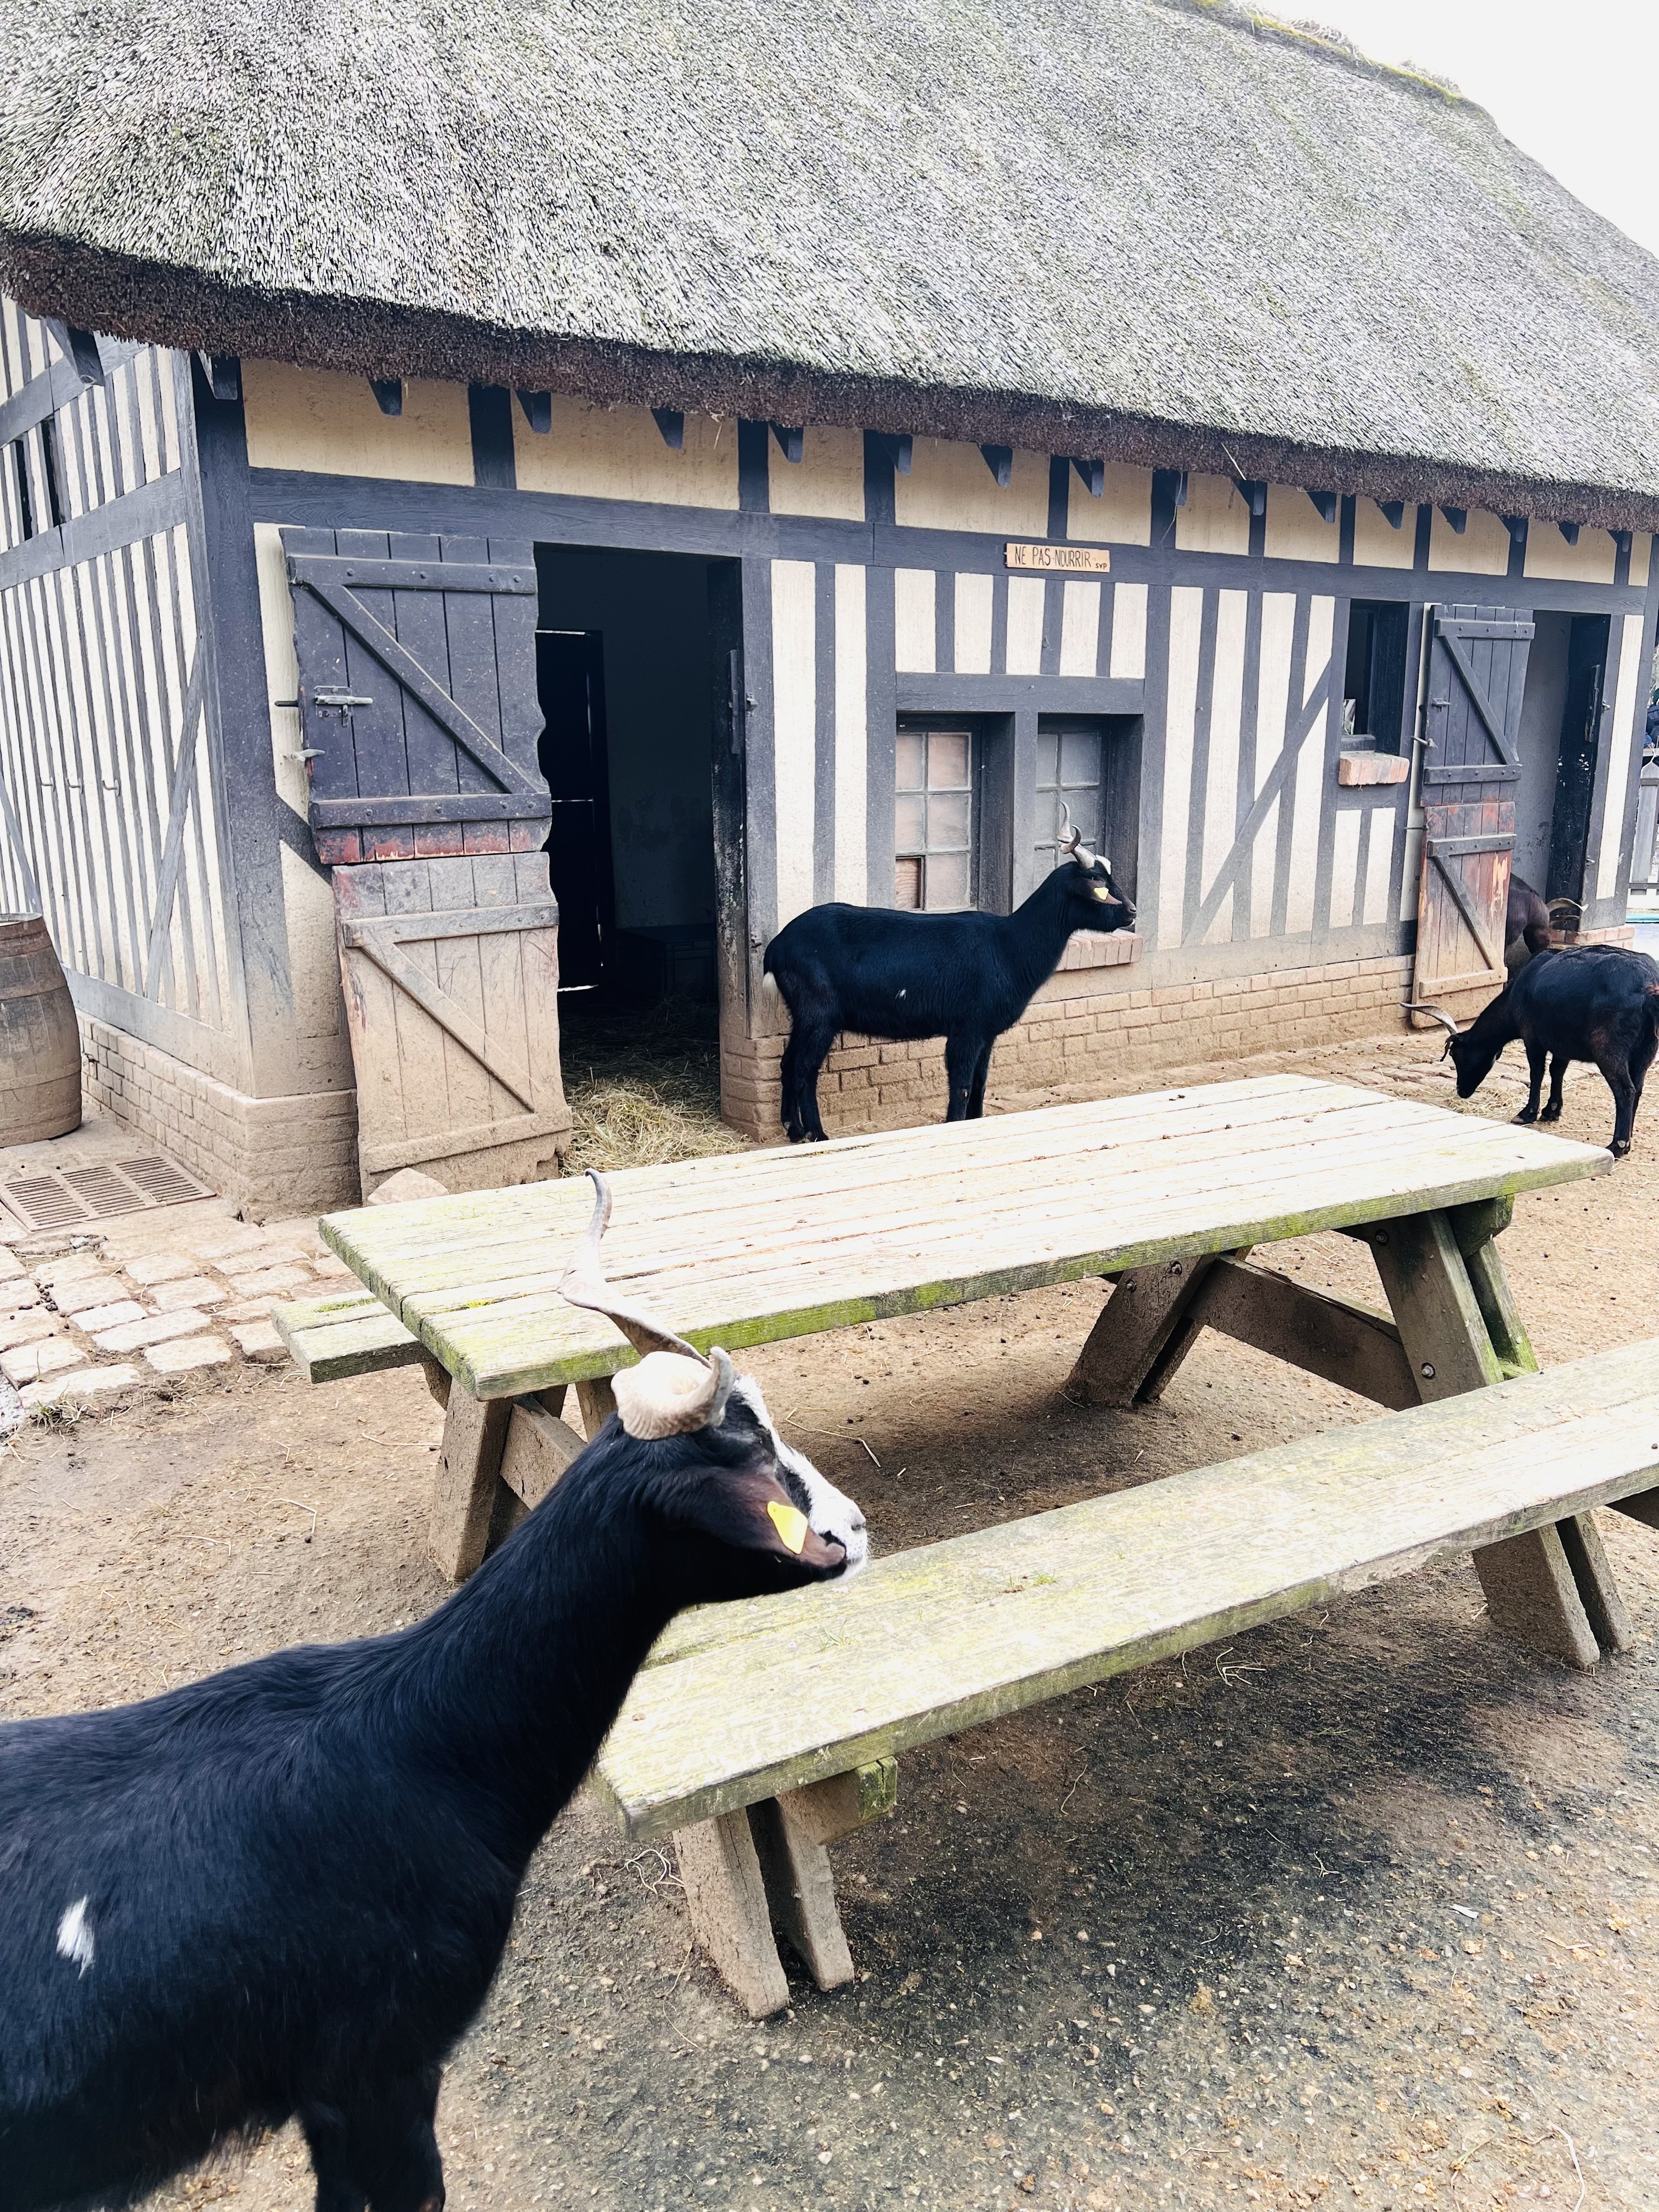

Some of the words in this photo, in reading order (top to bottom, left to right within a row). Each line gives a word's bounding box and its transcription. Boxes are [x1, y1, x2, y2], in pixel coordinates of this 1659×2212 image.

[1015, 546, 1026, 565] NE
[1032, 546, 1051, 566] PAS
[1055, 549, 1091, 567] NOURRIR
